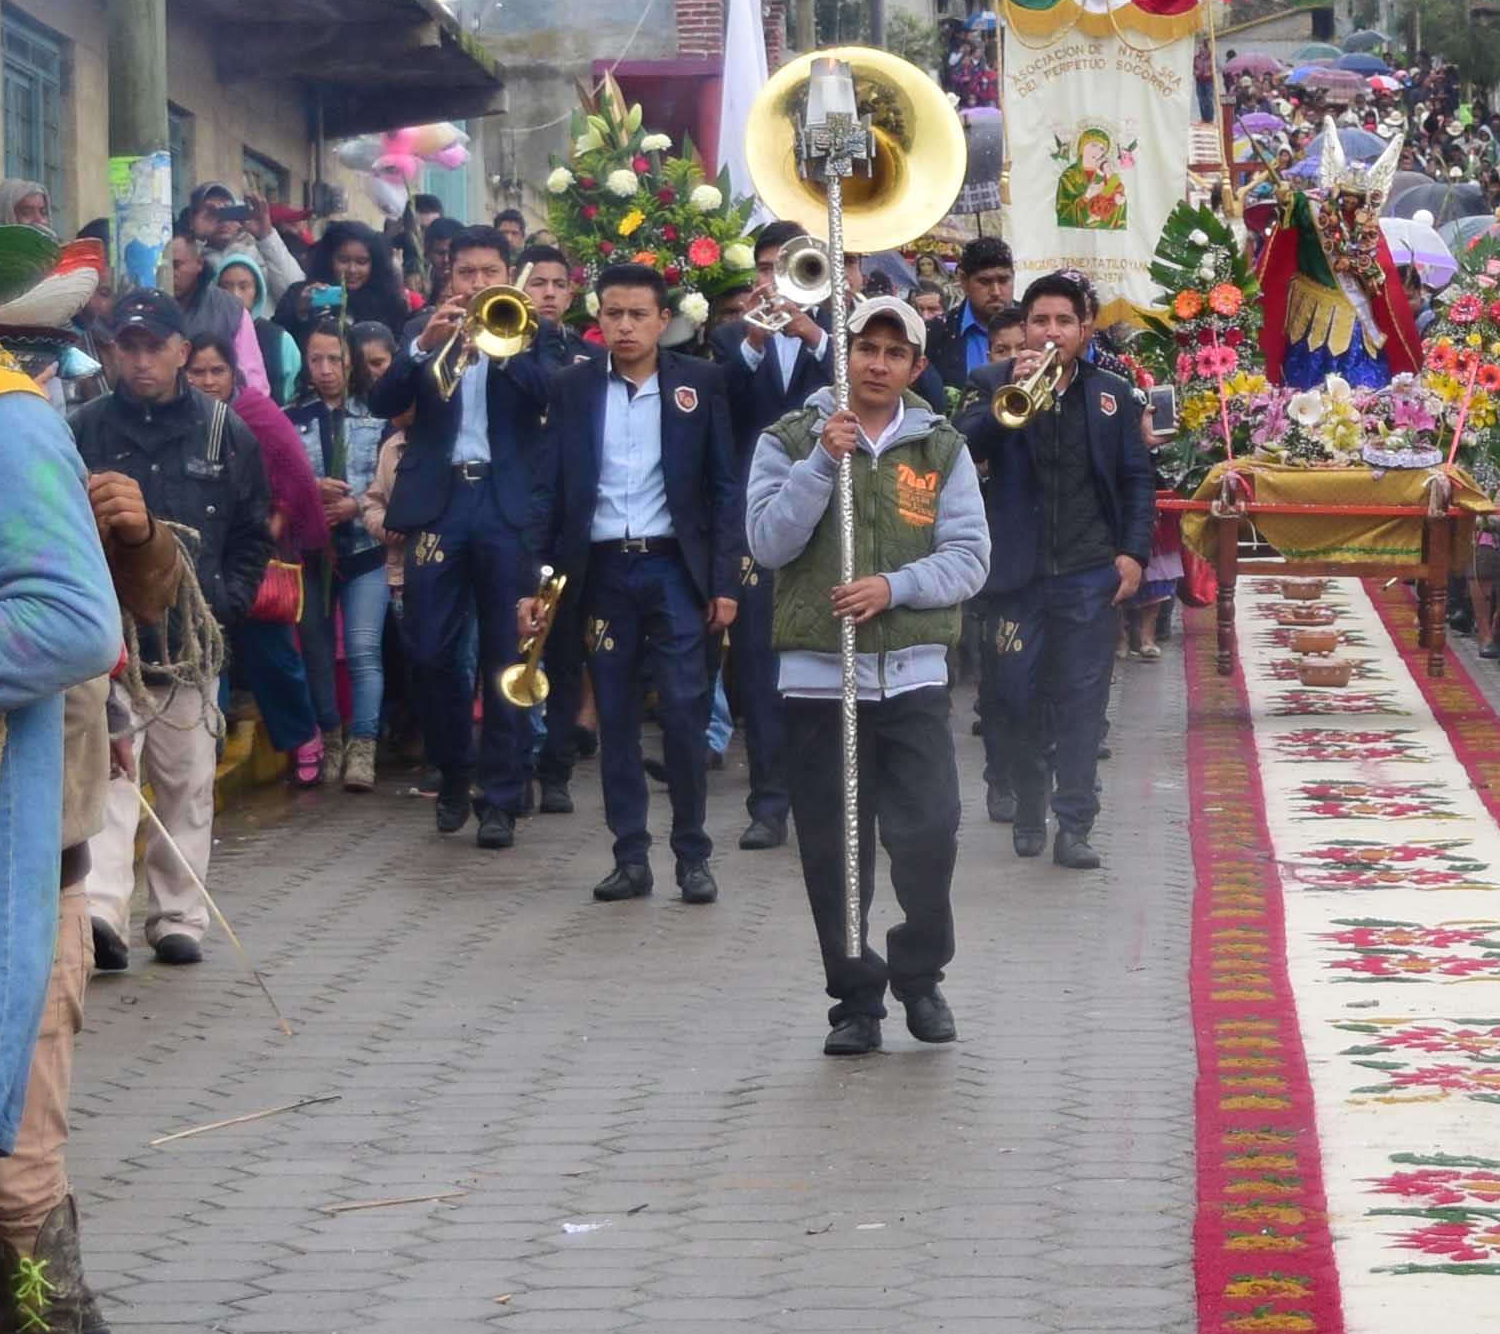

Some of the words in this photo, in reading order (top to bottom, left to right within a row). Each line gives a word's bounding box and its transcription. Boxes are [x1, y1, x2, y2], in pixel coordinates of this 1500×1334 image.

[1088, 42, 1105, 57] DE
[1043, 58, 1108, 80] PERPETUO
[1115, 59, 1174, 98] SOCORRO
